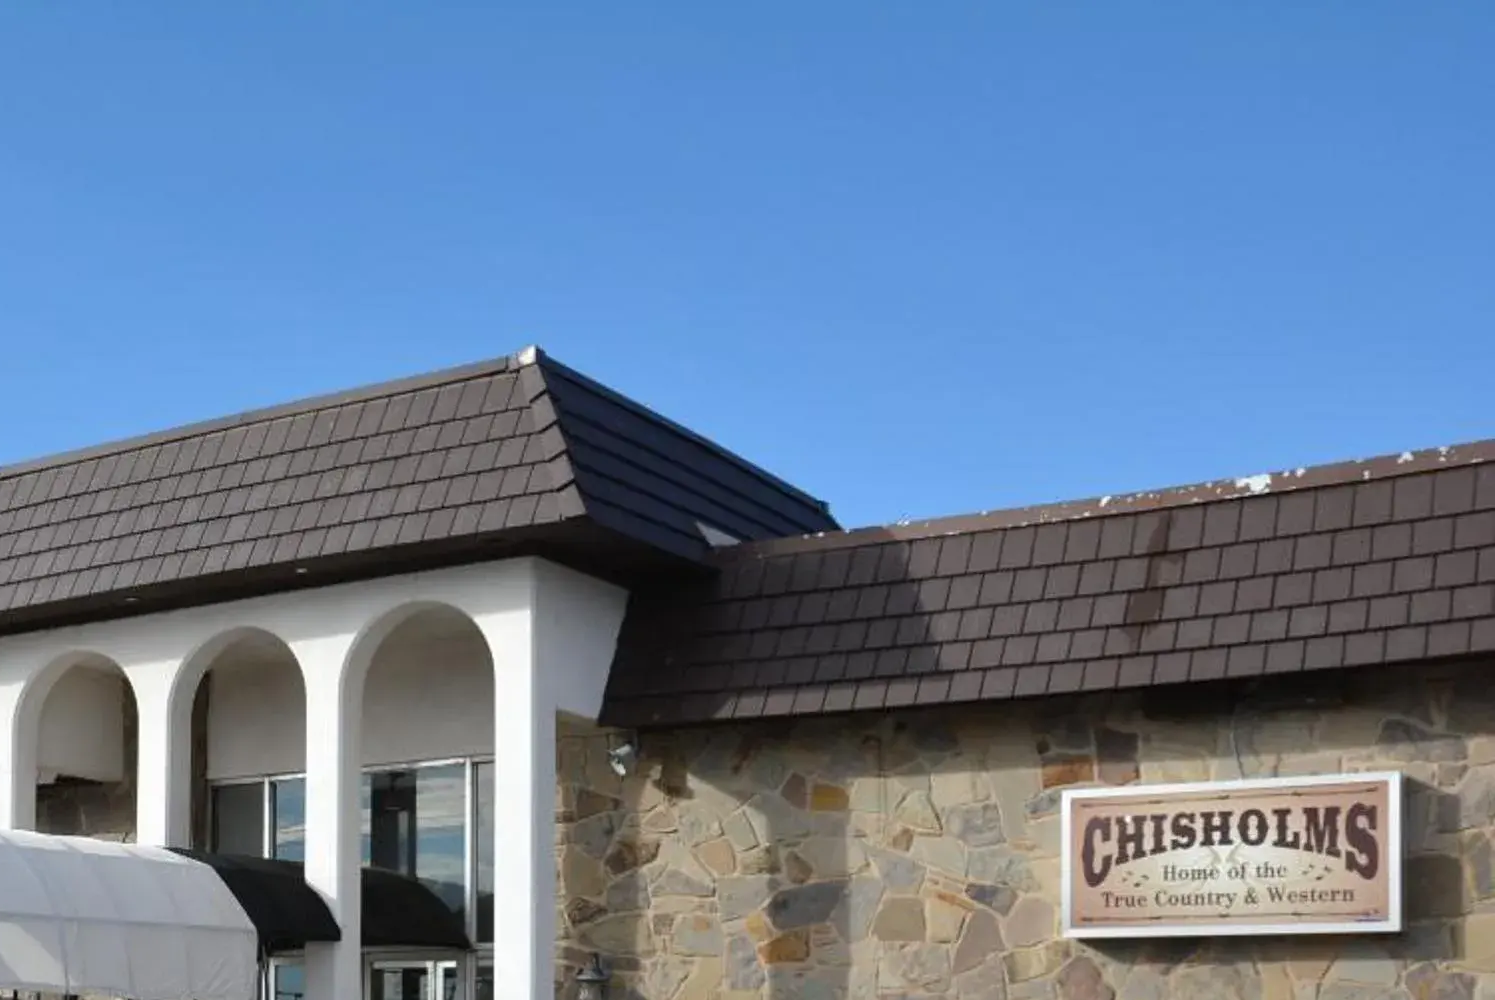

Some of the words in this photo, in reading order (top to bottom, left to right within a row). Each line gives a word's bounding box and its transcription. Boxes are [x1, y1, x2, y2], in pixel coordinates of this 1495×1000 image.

[1082, 802, 1379, 887] CHISHOLMS
[1163, 863, 1220, 882] Home
[1227, 862, 1248, 880] of
[1255, 860, 1287, 879] the
[1101, 891, 1147, 908] True
[1155, 887, 1237, 910] Country
[1244, 886, 1259, 905] &
[1267, 885, 1355, 904] Western
